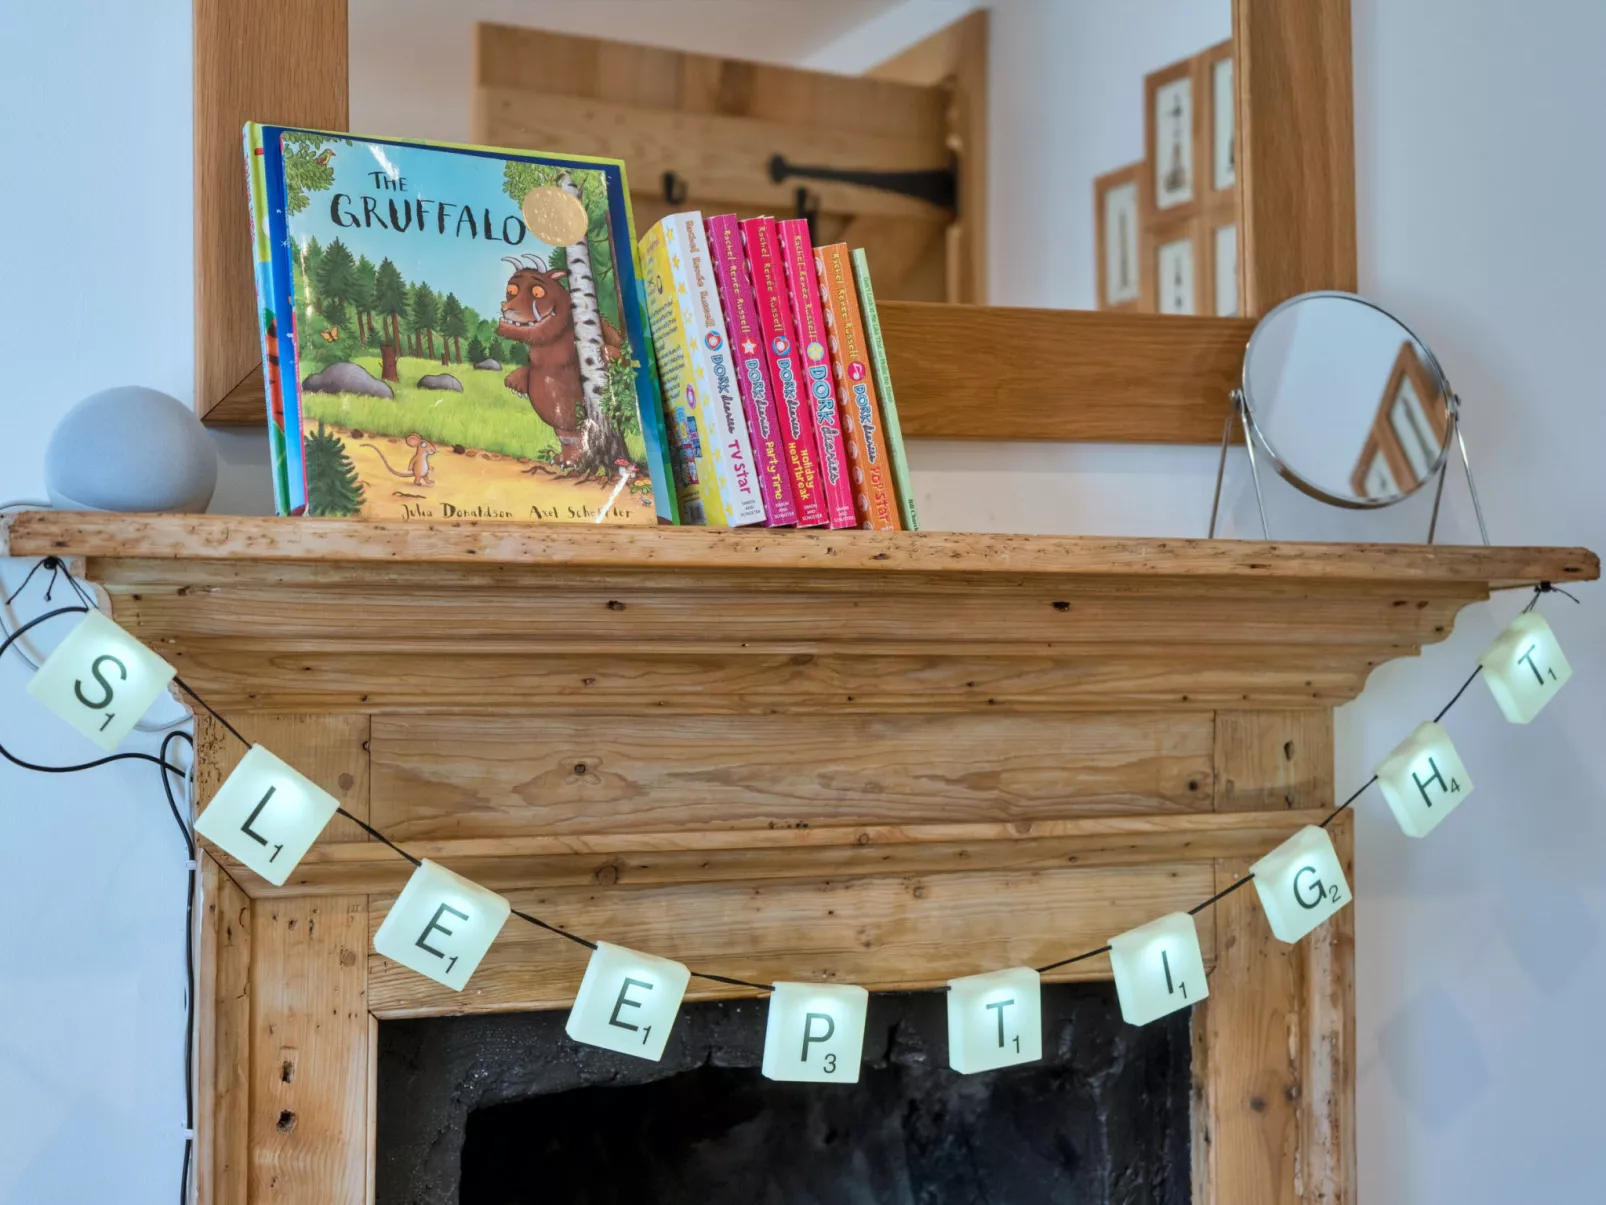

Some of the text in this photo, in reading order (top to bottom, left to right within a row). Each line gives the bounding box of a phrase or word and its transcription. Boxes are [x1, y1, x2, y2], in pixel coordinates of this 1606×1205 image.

[368, 171, 408, 191] THE
[330, 193, 527, 245] GRUFFALO
[686, 220, 700, 253] Rachel
[724, 229, 737, 261] Rachel
[737, 298, 750, 333] Russell
[758, 226, 771, 258] Rachel
[770, 296, 783, 332] Russell
[805, 303, 818, 339] Russell
[832, 253, 844, 285] Rachel
[845, 323, 858, 358] Russell
[711, 354, 729, 394] DORK
[745, 358, 765, 399] DORK
[777, 358, 796, 399] DORK
[809, 365, 839, 485] DORK diaries
[853, 383, 872, 425] DORK
[728, 440, 751, 494] TV Star
[765, 441, 783, 499] Party Time
[788, 442, 809, 500] Heartbreak
[801, 449, 815, 488] Holiday
[401, 503, 433, 520] Julia
[440, 503, 513, 518] Donaldson
[530, 505, 560, 519] Axel
